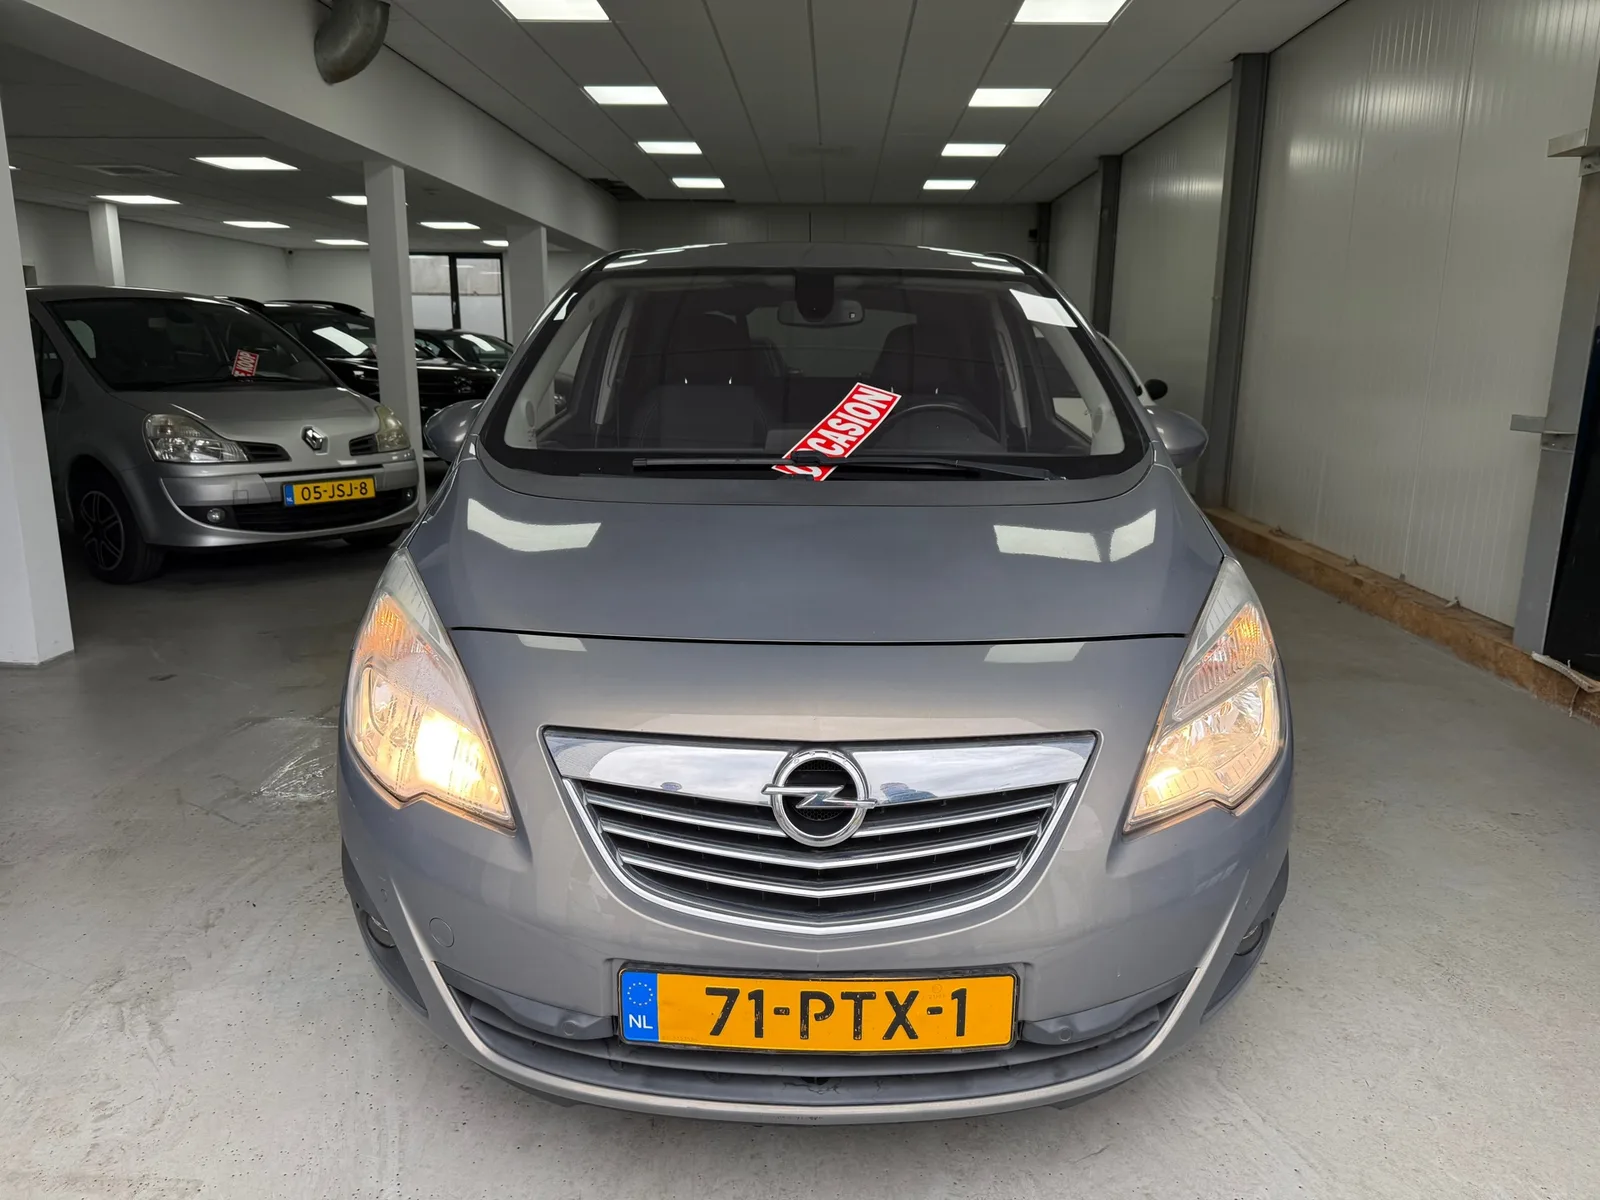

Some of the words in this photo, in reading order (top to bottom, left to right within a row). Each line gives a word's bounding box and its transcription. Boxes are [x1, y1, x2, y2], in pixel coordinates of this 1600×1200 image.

[236, 351, 256, 373] KOOP
[784, 386, 894, 478] OCASION
[301, 481, 368, 501] 05-JSJ-8
[628, 1013, 654, 1030] NL
[705, 986, 968, 1041] 71-PTX-1
